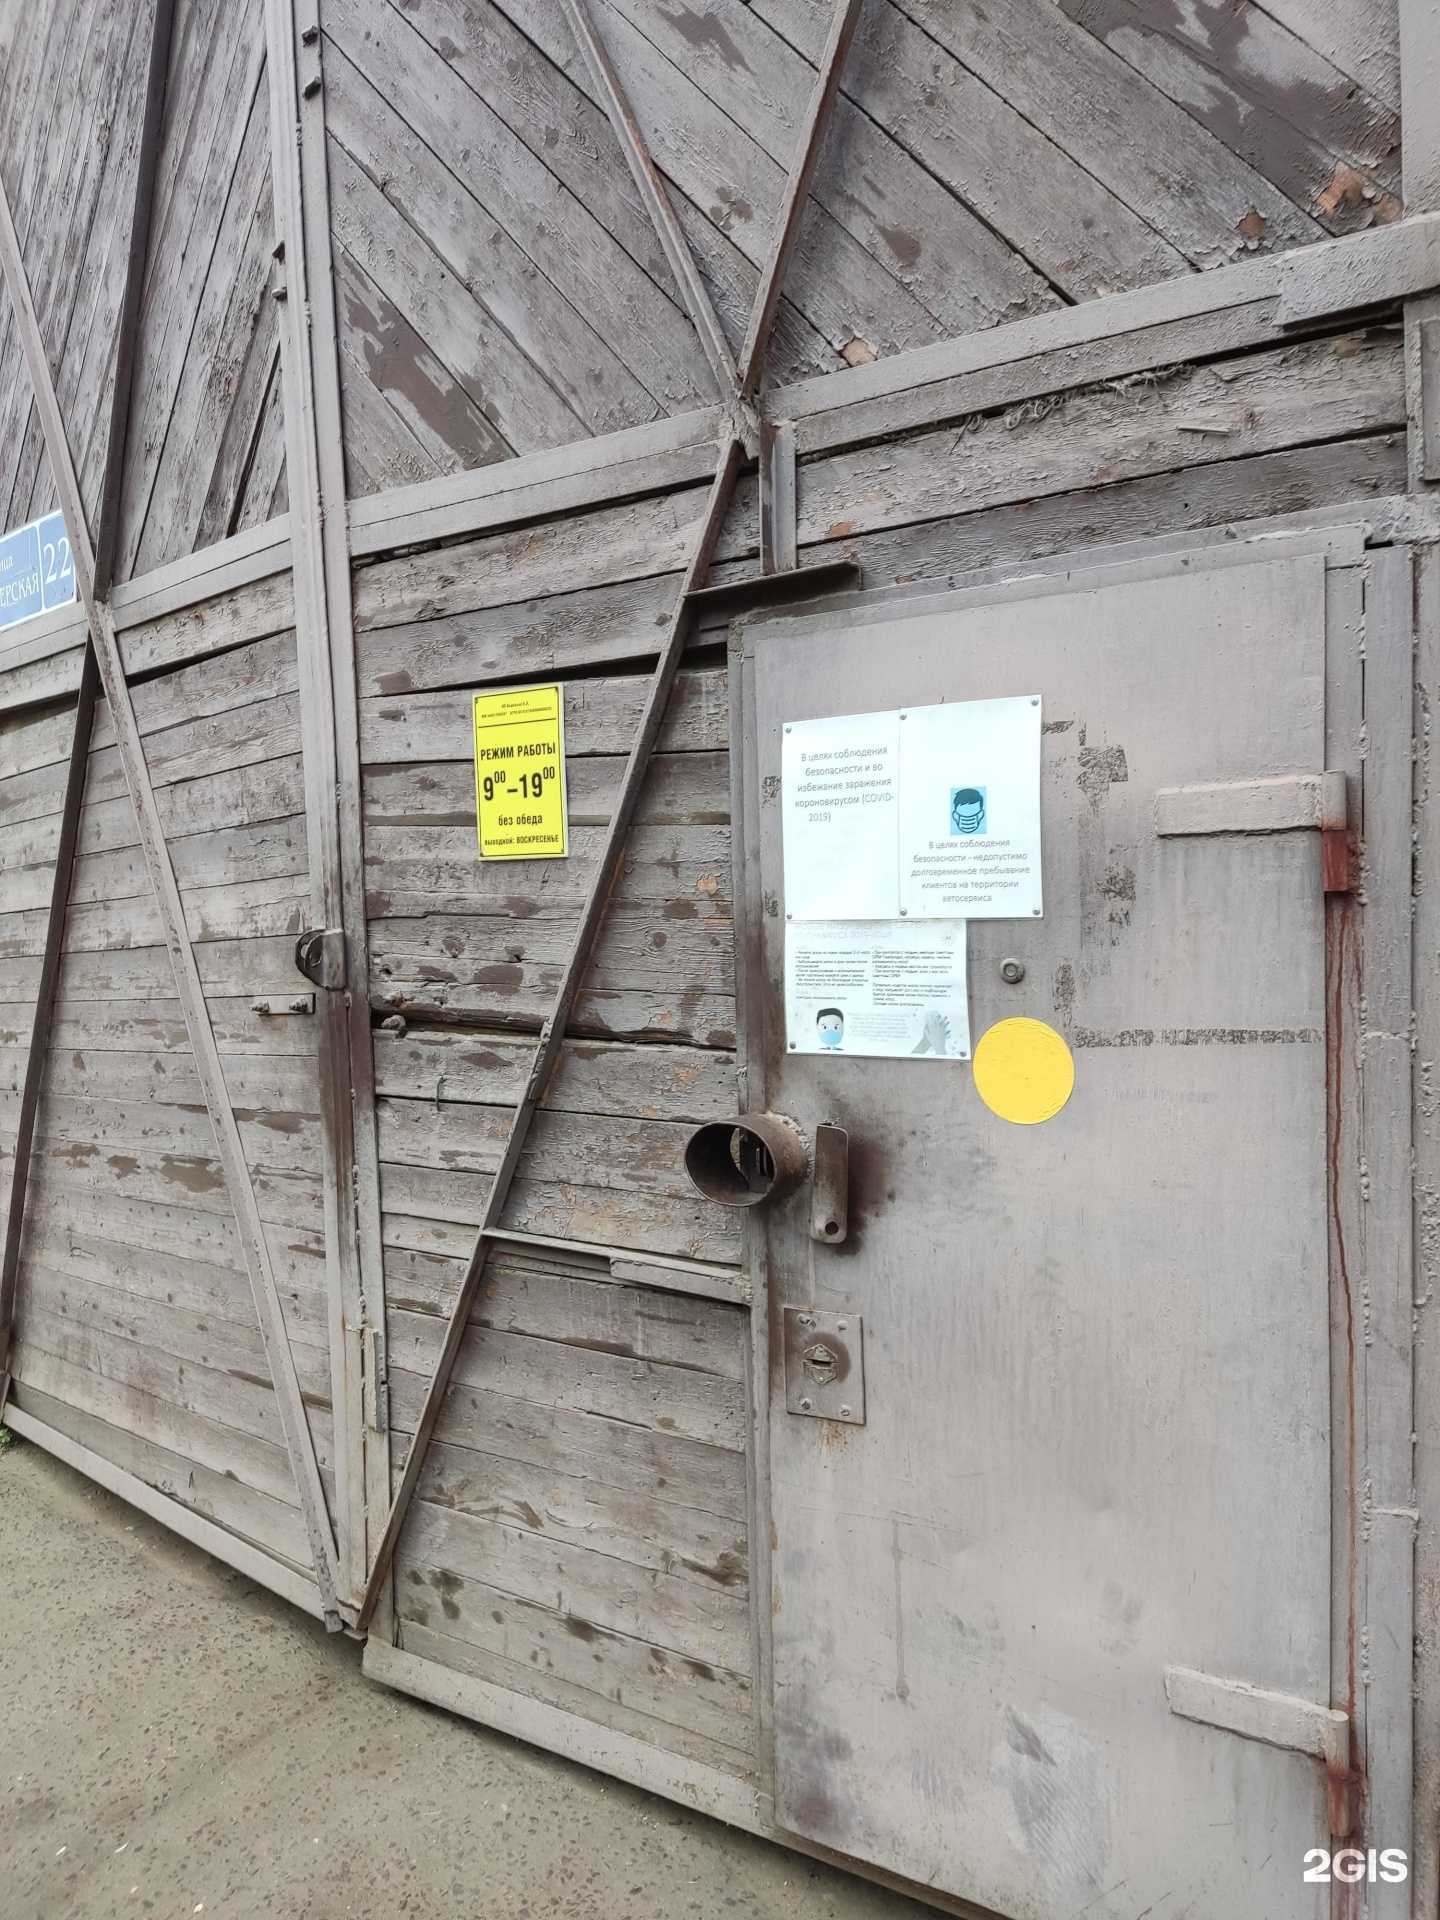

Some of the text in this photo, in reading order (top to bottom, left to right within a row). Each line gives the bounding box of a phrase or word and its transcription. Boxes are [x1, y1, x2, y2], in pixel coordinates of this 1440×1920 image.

[43, 537, 72, 585] 22
[0, 572, 40, 607] ЕРСКАЯ
[480, 742, 556, 761] РЕЖИМ РАБОТЫ
[800, 746, 888, 763] В целях соблюдения
[805, 764, 863, 777] безопасности
[872, 763, 883, 771] во
[797, 777, 892, 792] избежание заражения
[498, 813, 543, 826] без обеда
[808, 811, 832, 823] 2019)
[935, 841, 958, 850] целях
[959, 839, 1010, 848] соблюдения
[973, 853, 1028, 863] недопустимо
[910, 866, 1031, 878] долговременное пребывание
[921, 881, 957, 889] клиентов
[970, 881, 1019, 890] территории
